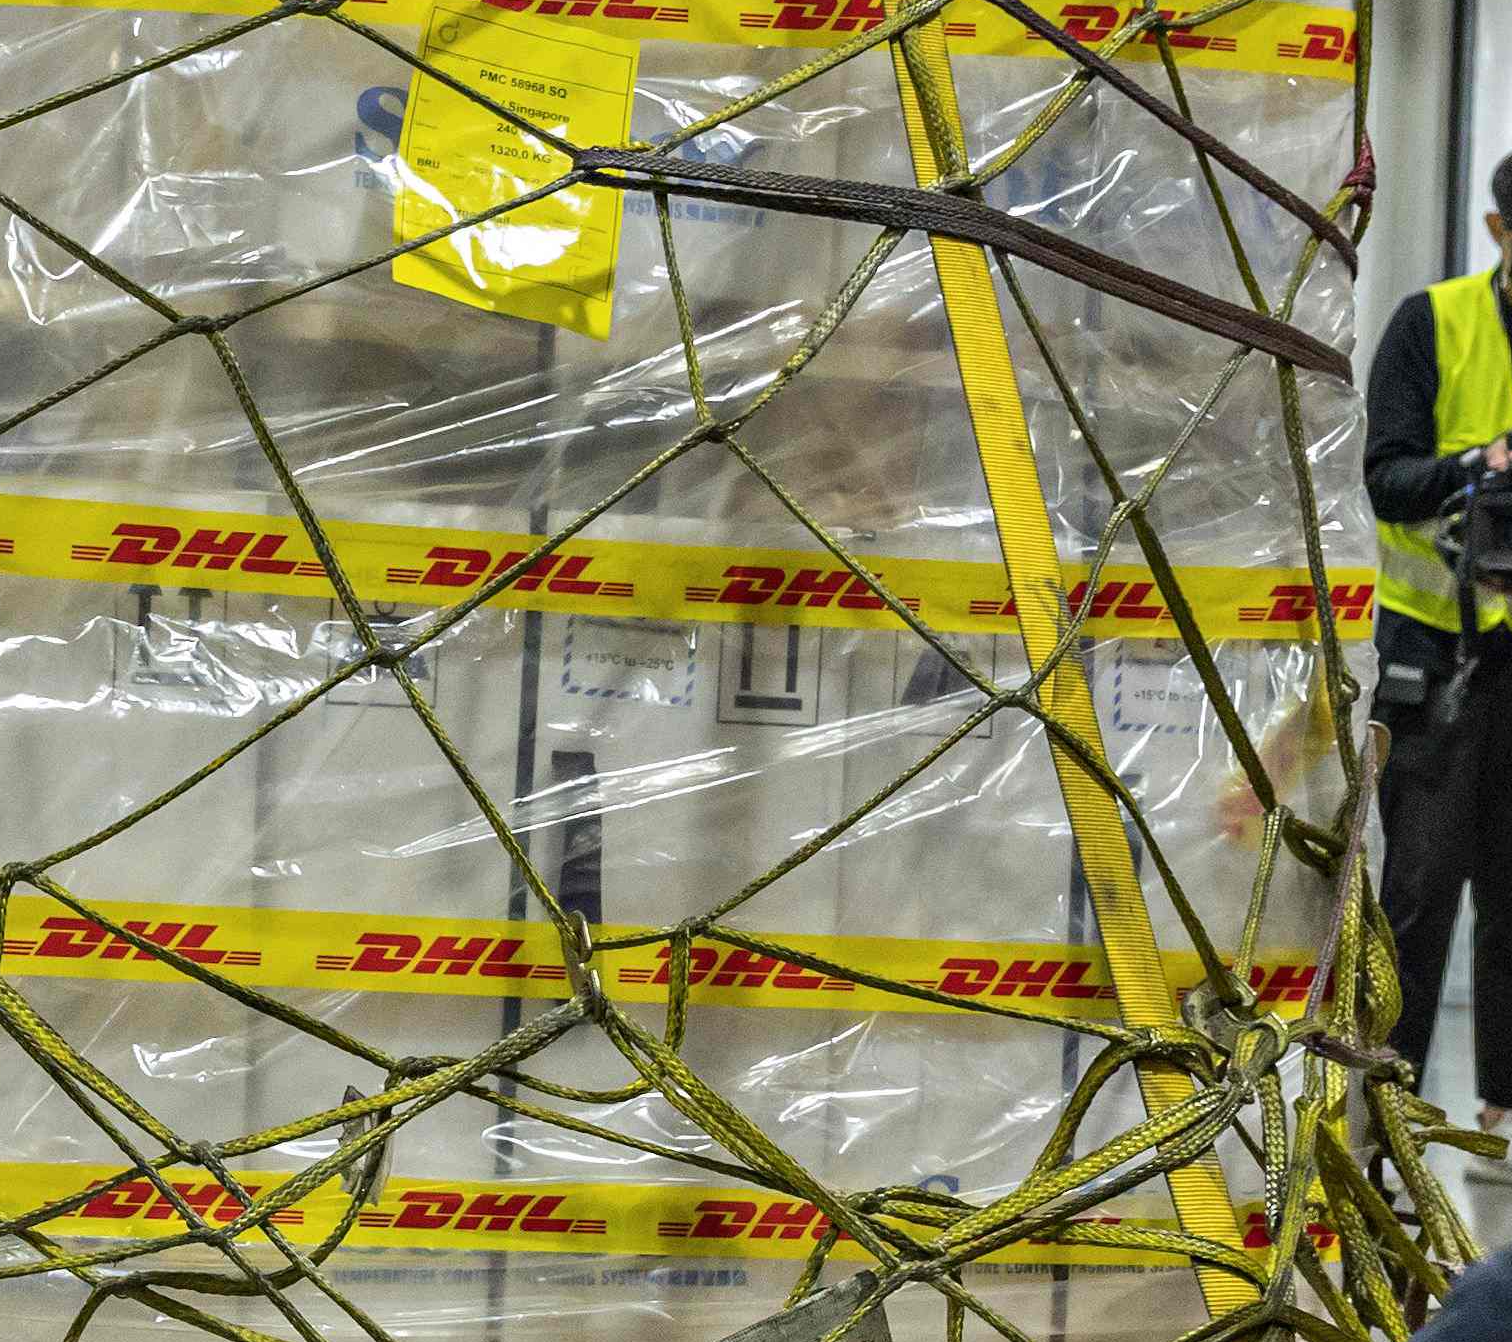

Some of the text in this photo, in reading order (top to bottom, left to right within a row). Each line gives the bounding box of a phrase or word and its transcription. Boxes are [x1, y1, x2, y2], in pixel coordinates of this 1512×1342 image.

[479, 69, 569, 100] PMC 58968 SQ
[508, 102, 571, 124] Singapore
[416, 158, 441, 169] BRU
[532, 151, 553, 164] KG
[112, 525, 294, 573] DHL
[1002, 583, 1160, 618] HL
[38, 918, 224, 963] DHL
[352, 934, 531, 976] DHL
[942, 960, 1104, 997] DHL
[396, 1193, 569, 1231] DHL
